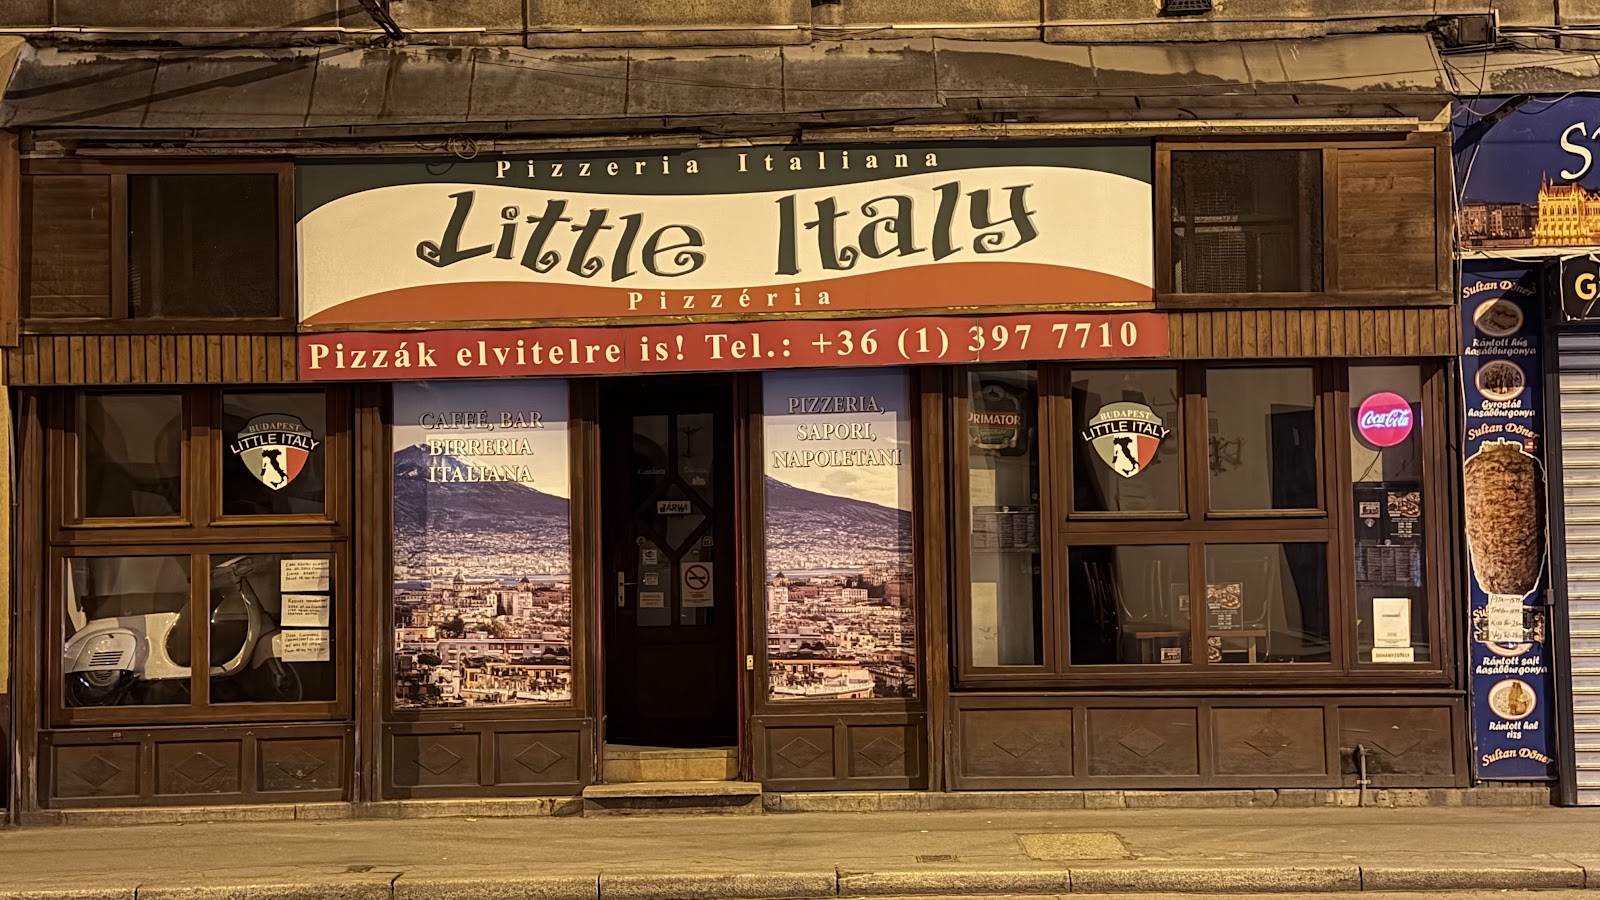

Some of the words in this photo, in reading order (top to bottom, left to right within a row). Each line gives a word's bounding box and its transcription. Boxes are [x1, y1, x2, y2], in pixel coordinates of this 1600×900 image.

[1560, 121, 1600, 180] S
[496, 156, 699, 179] Pizzeria
[738, 150, 939, 172] Italiana
[416, 188, 707, 282] Little
[775, 180, 1039, 276] Italy
[628, 288, 831, 310] Pizzéria
[1463, 281, 1498, 299] Sultan
[1499, 280, 1534, 296] Döner
[309, 341, 438, 369] Pizzák
[457, 337, 621, 366] elvitelre
[640, 333, 685, 361] is!
[705, 331, 791, 360] Tel.:
[812, 329, 878, 356] +36
[898, 327, 949, 358] (1)
[968, 323, 1032, 352] 397
[1052, 320, 1138, 349] 7710
[1465, 346, 1536, 357] hasábburgonya
[1473, 337, 1510, 348] Rántott
[1511, 337, 1528, 348] hús
[787, 396, 886, 415] PIZZERIA,
[1481, 399, 1522, 411] Gyrostál
[418, 409, 495, 432] CAFFÉ,
[499, 410, 544, 429] BAR
[968, 411, 1021, 426] PRIMATOR
[1099, 410, 1152, 421] BUDAPEST
[1361, 409, 1412, 429] Coca-Cola
[248, 422, 301, 433] BUDAPEST
[797, 422, 877, 442] SAPORI,
[1081, 420, 1129, 441] LITTLE
[1132, 420, 1172, 439] ITALY
[1468, 423, 1503, 441] Sultan
[1505, 423, 1541, 440] Döner
[230, 432, 278, 455] LITTLE
[281, 431, 320, 451] ITALY
[428, 438, 534, 457] BIRRERIA
[772, 449, 902, 469] NAPOLETANI
[428, 465, 534, 483] ITALIANA
[1476, 665, 1548, 676] hasábburgonya
[1482, 656, 1520, 667] Rántott
[1521, 656, 1540, 667] sajt
[1489, 720, 1522, 732] Rántott
[1523, 720, 1539, 730] hal
[1506, 729, 1522, 740] rizs
[1481, 748, 1517, 767] Sultan
[1518, 747, 1554, 766] Döner
